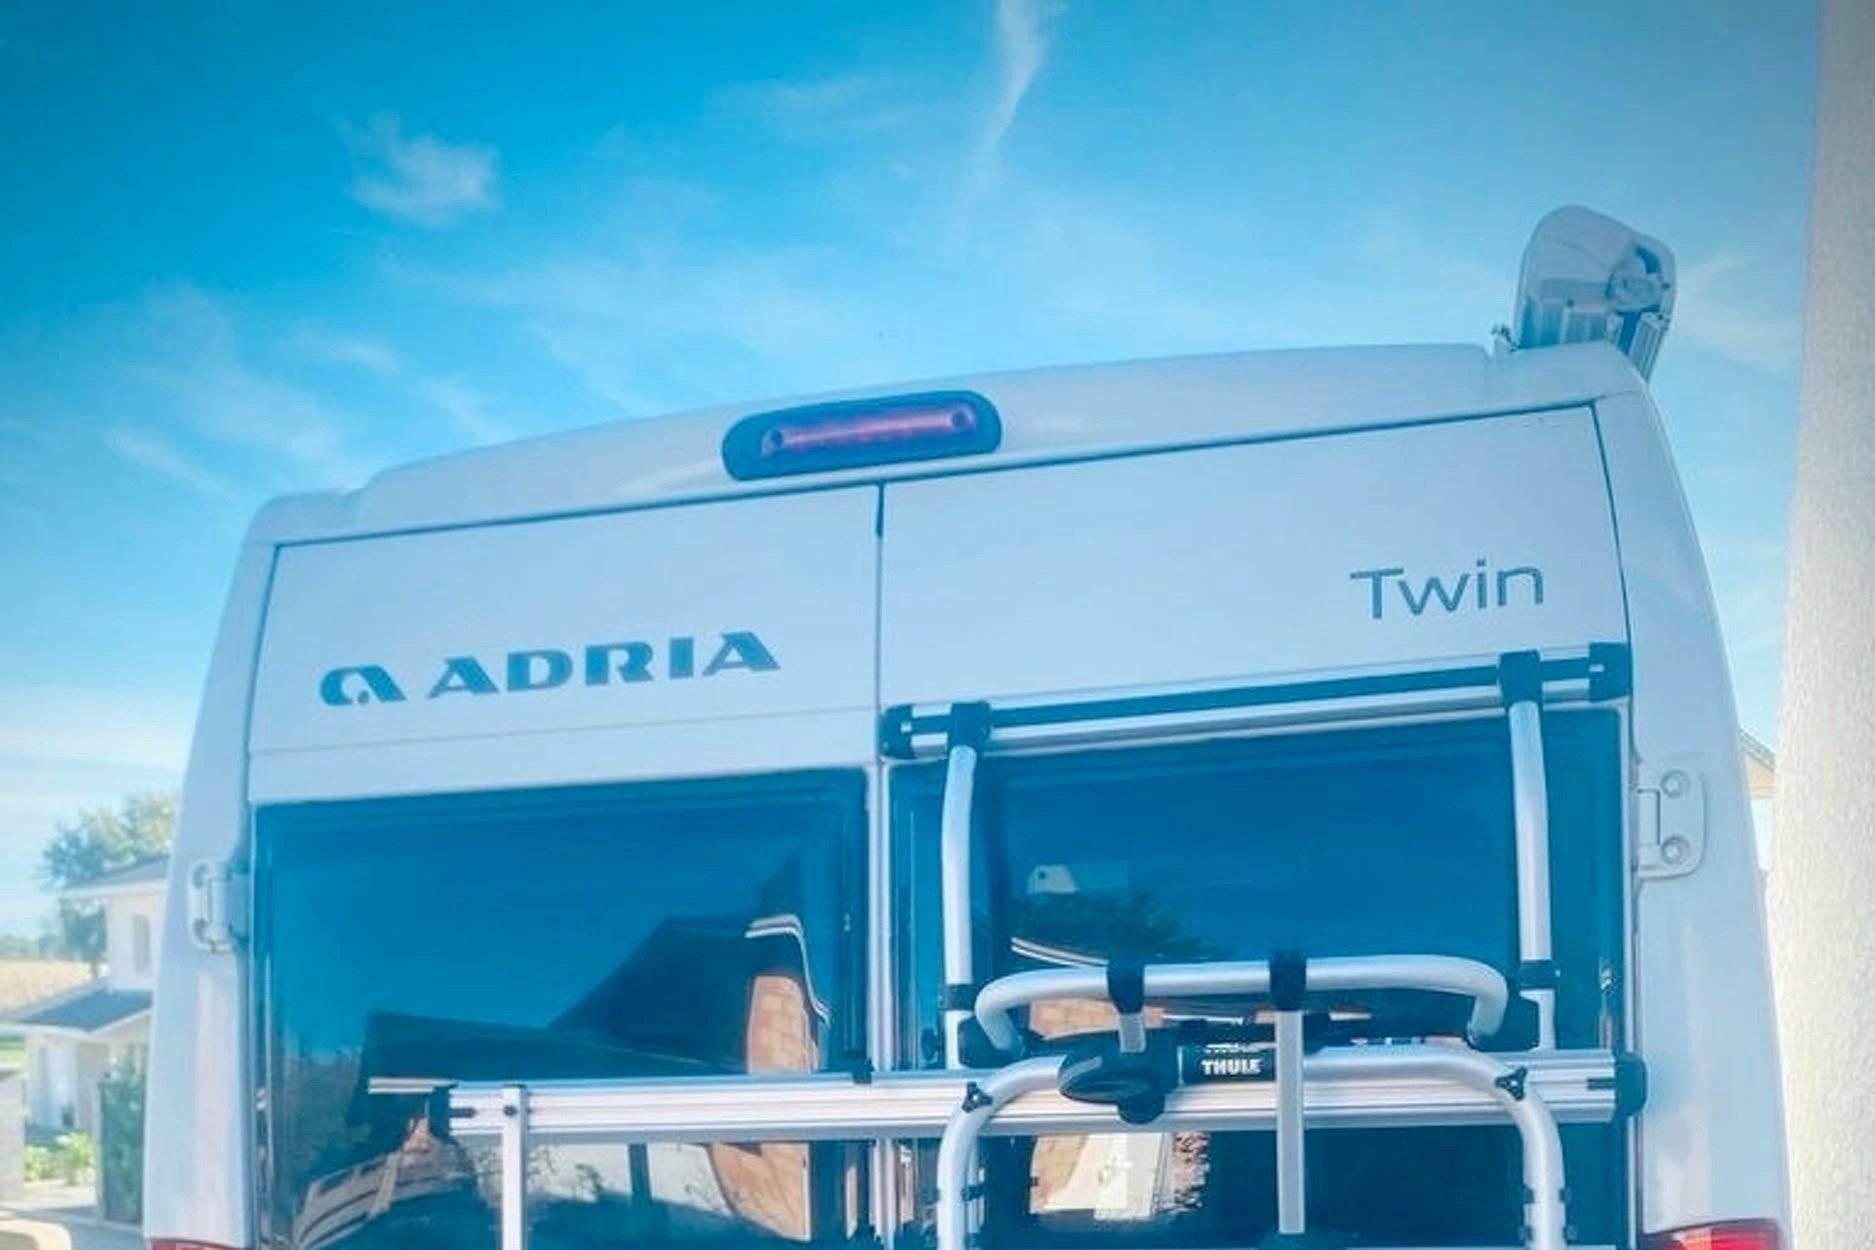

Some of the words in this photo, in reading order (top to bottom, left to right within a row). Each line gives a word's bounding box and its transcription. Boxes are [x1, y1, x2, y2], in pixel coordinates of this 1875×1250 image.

[1350, 558, 1544, 619] Twin
[427, 631, 781, 699] ADRIA
[1201, 1058, 1262, 1075] THULE
